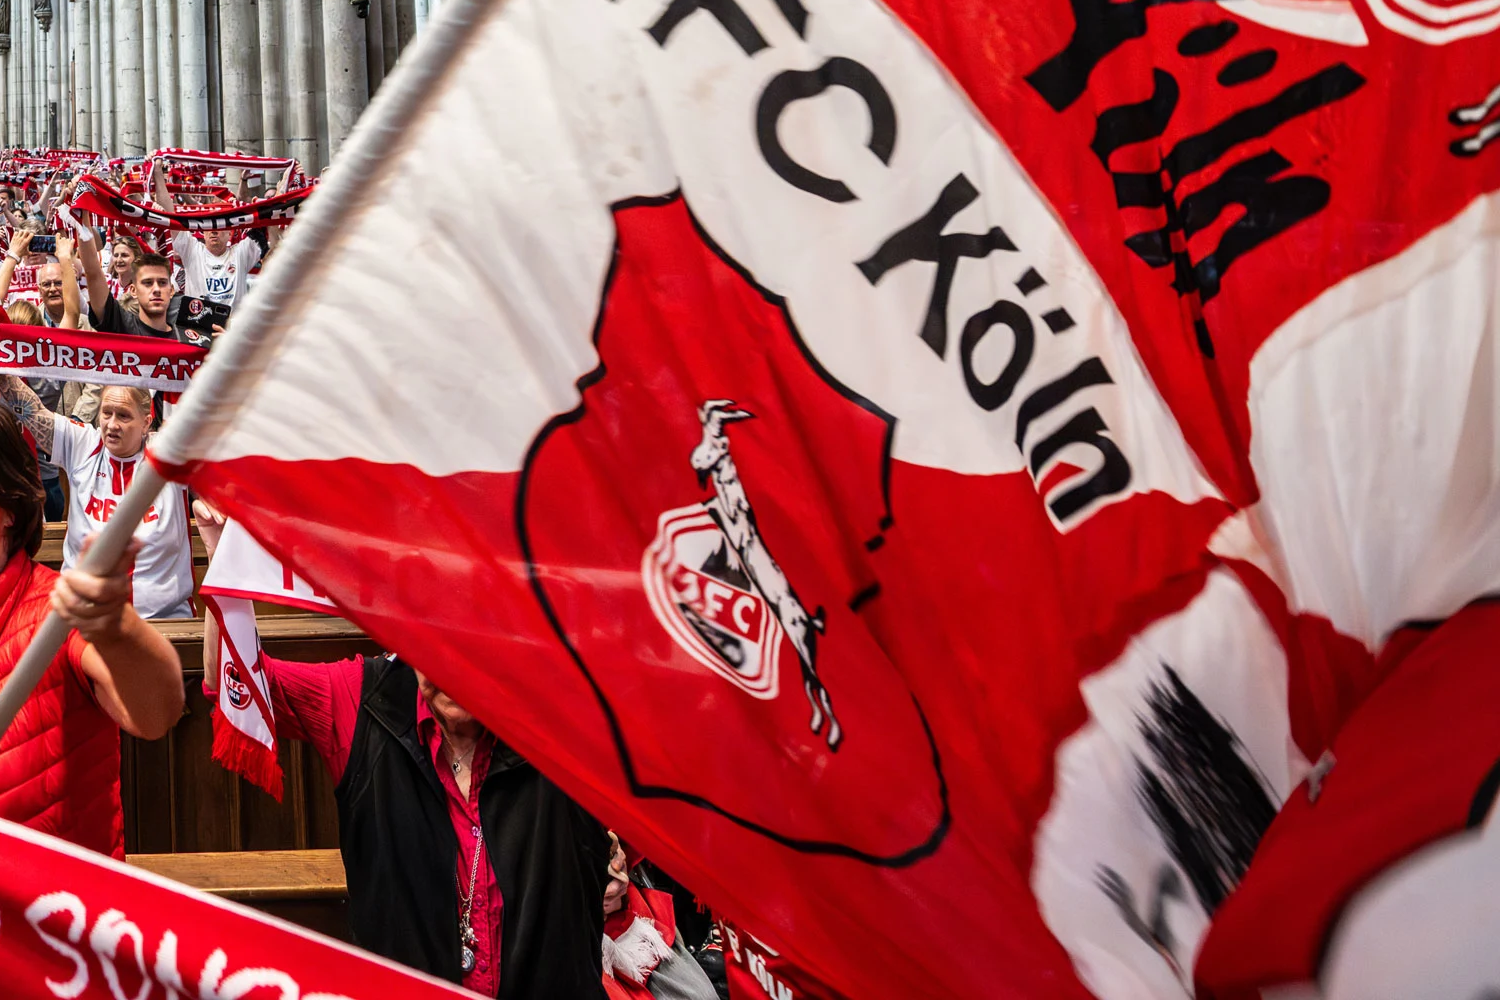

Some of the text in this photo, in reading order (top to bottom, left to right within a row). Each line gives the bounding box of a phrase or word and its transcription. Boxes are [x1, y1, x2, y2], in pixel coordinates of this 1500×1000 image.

[206, 277, 228, 291] VPV
[855, 173, 1131, 526] Köln
[85, 495, 159, 524] REE
